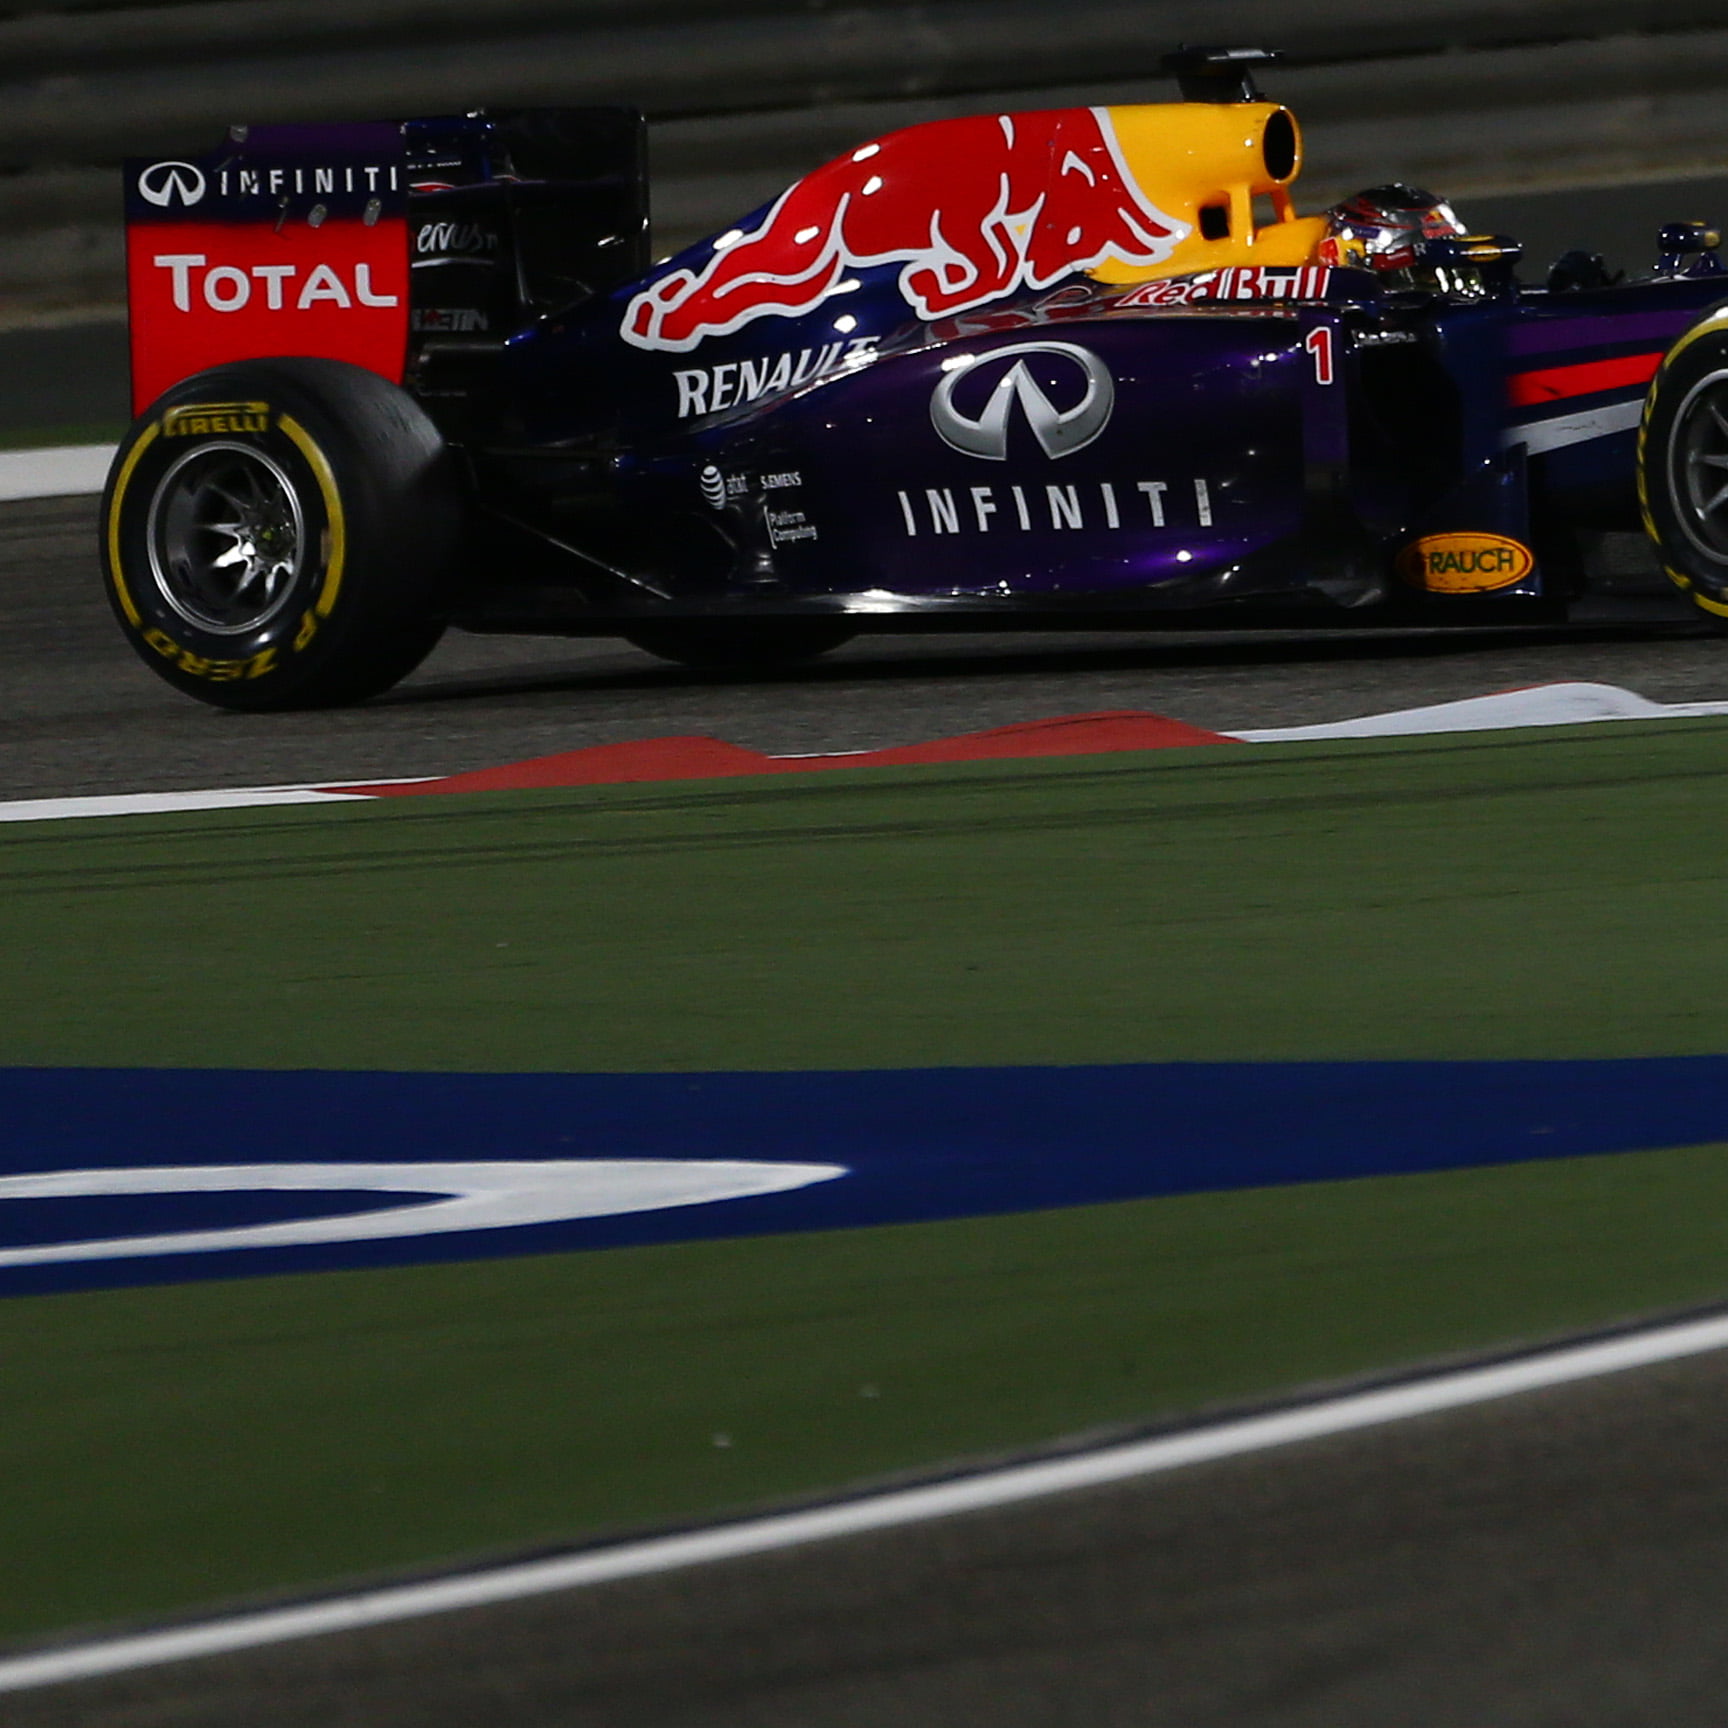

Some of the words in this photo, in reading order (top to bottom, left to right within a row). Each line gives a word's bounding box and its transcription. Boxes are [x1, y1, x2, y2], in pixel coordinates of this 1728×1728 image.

[219, 166, 398, 196] INFINITI
[154, 253, 398, 313] TOTAL
[672, 335, 882, 418] RENAULT
[1305, 326, 1334, 384] 1
[162, 401, 270, 437] PIRELLI
[898, 479, 1214, 537] INFINITI
[1428, 548, 1515, 575] RAUCH
[142, 626, 279, 682] ZERO
